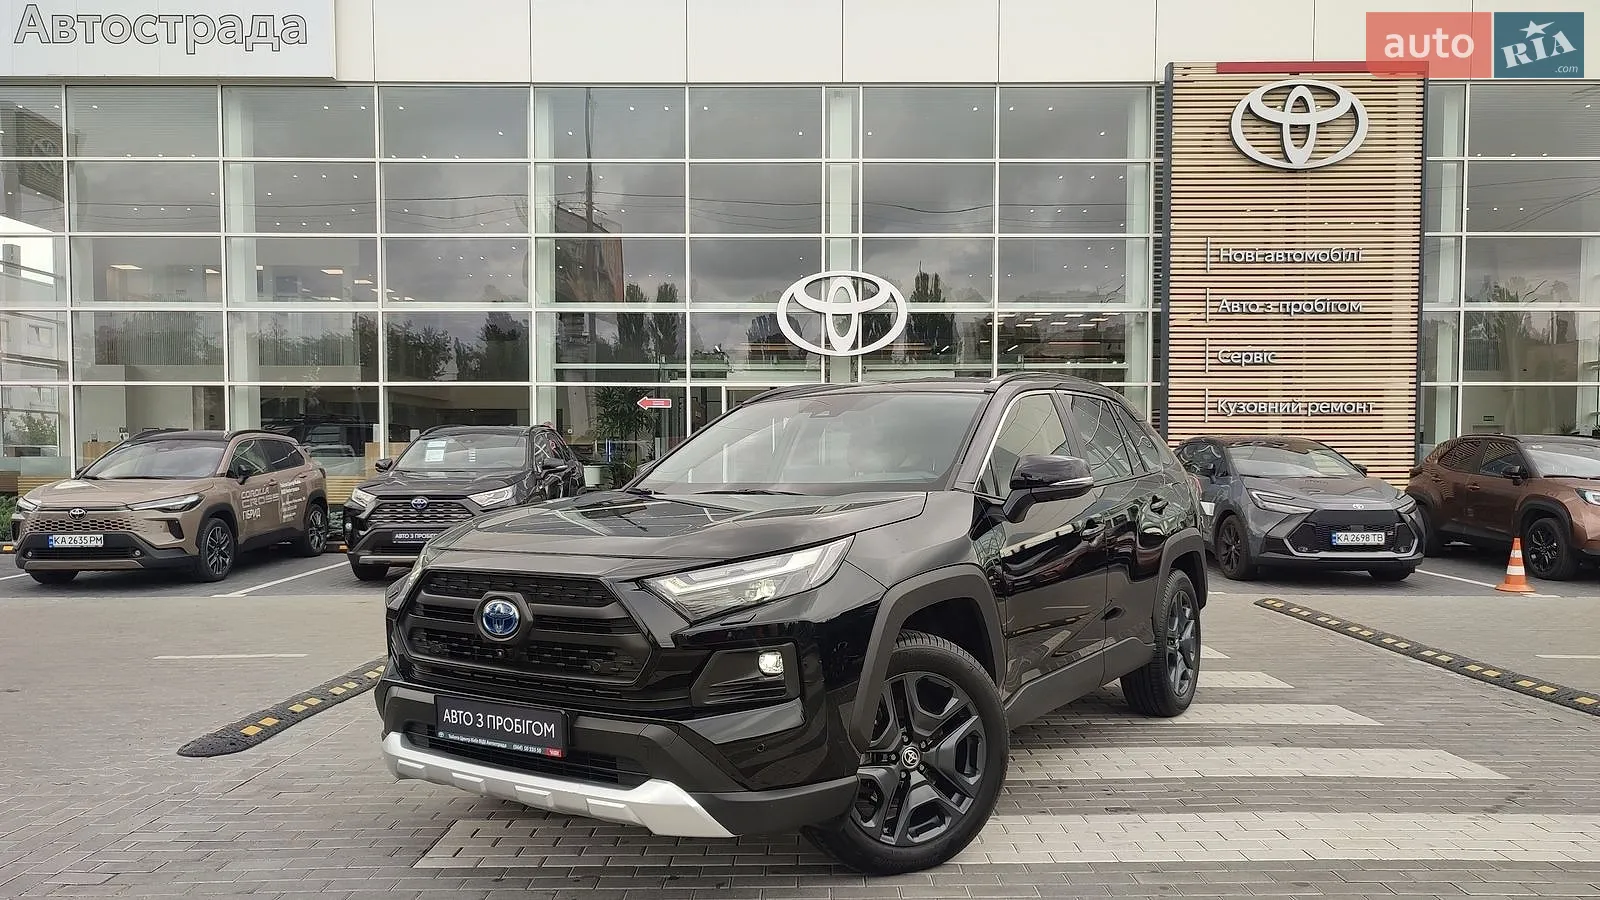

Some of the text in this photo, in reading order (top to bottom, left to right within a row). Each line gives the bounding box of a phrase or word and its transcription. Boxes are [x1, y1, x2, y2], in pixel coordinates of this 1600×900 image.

[14, 4, 308, 55] Автострада
[1219, 247, 1363, 262] Нові автомобілі
[1218, 298, 1363, 316] Авто з пробігом
[1217, 349, 1277, 367] Сервіс
[1217, 398, 1376, 417] Кузовний ремонт
[241, 487, 270, 500] COROLLA
[241, 493, 280, 509] CROSS
[443, 708, 556, 739] АВТО З ПРОБІГОМ
